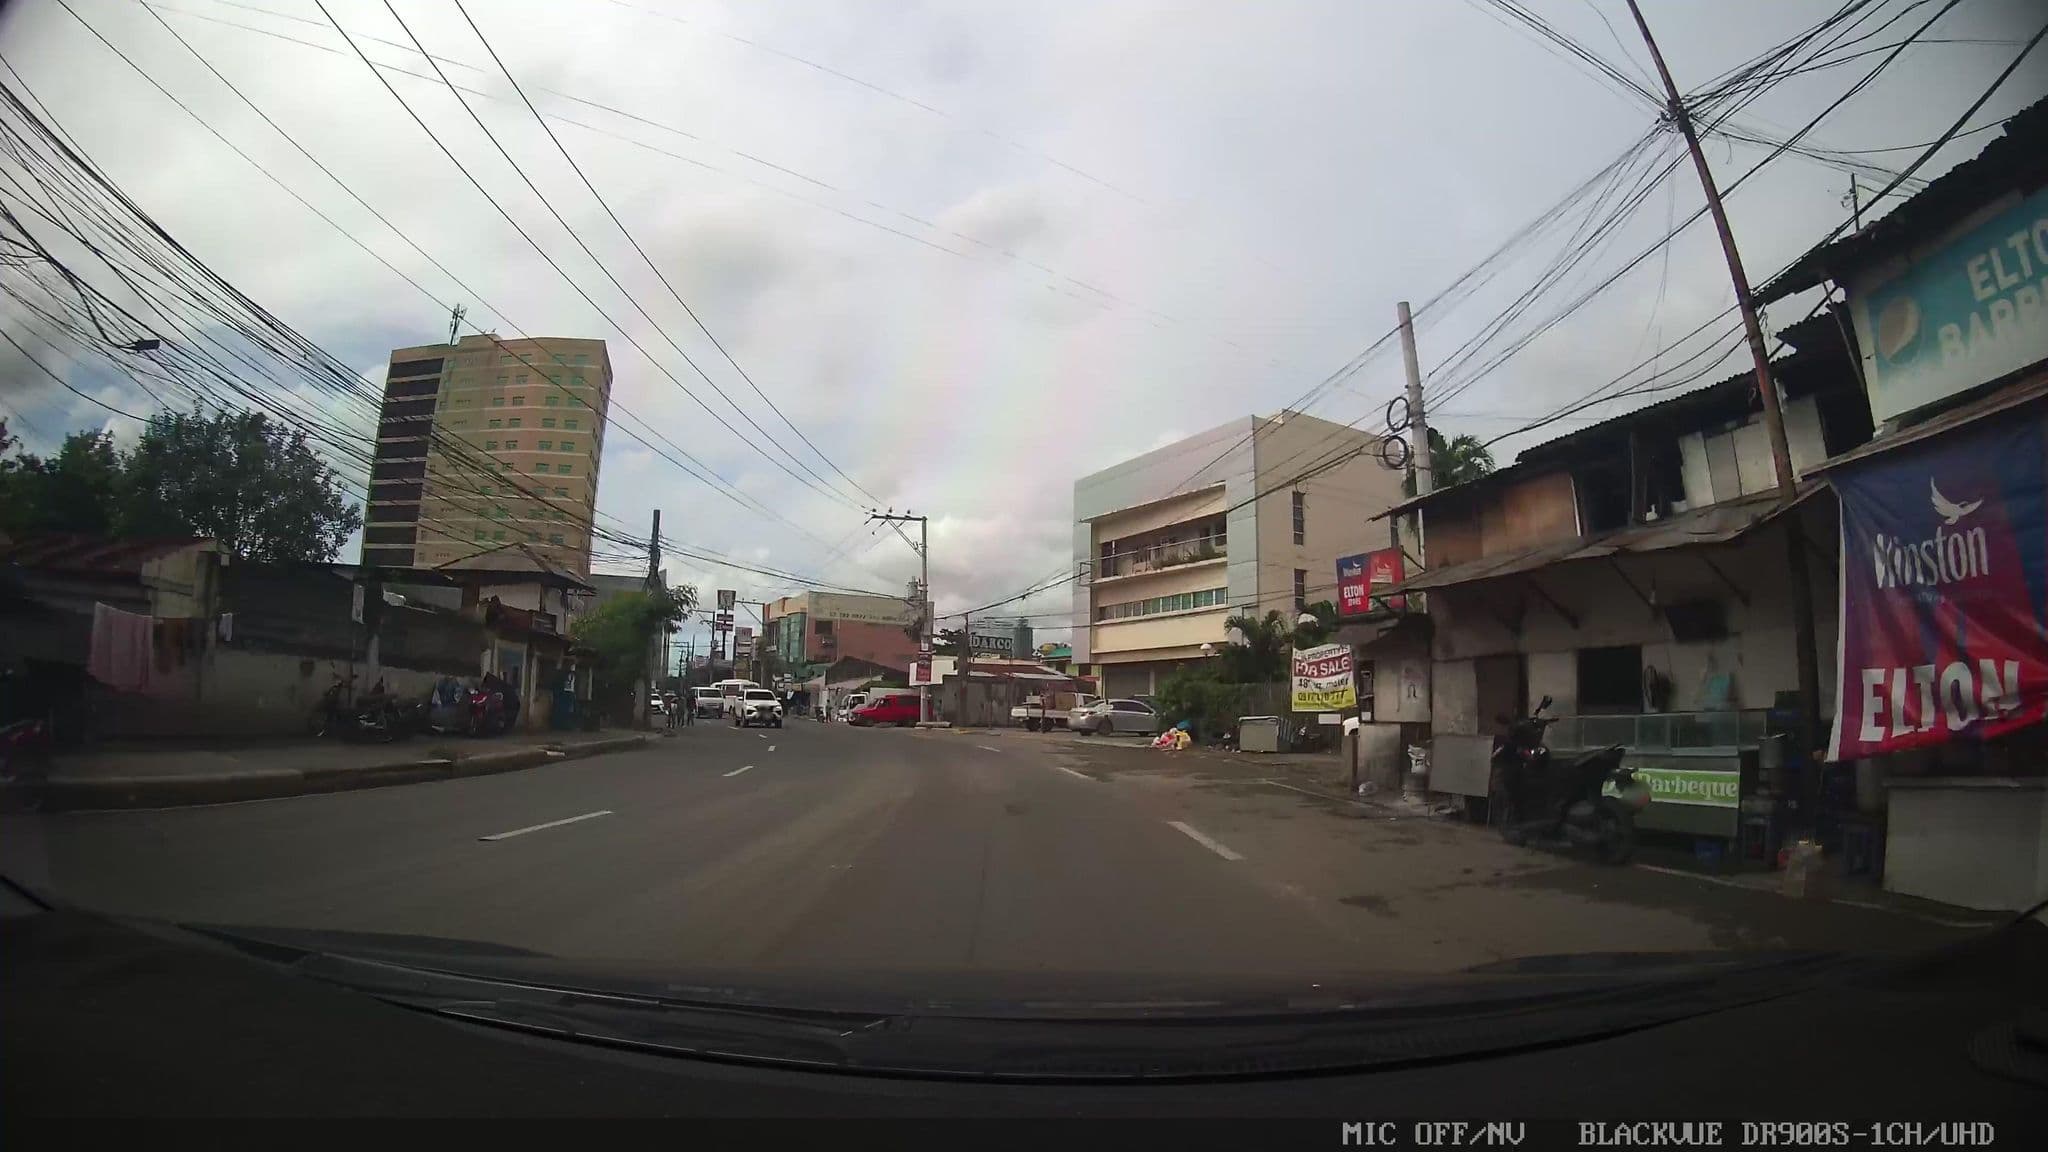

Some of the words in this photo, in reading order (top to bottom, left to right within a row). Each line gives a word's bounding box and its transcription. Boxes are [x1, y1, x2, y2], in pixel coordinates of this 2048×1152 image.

[1874, 526, 1989, 589] Winston
[1344, 584, 1364, 599] ELTON
[1295, 660, 1318, 676] FOR
[1320, 656, 1350, 676] SALE
[1859, 659, 2020, 742] ELTON
